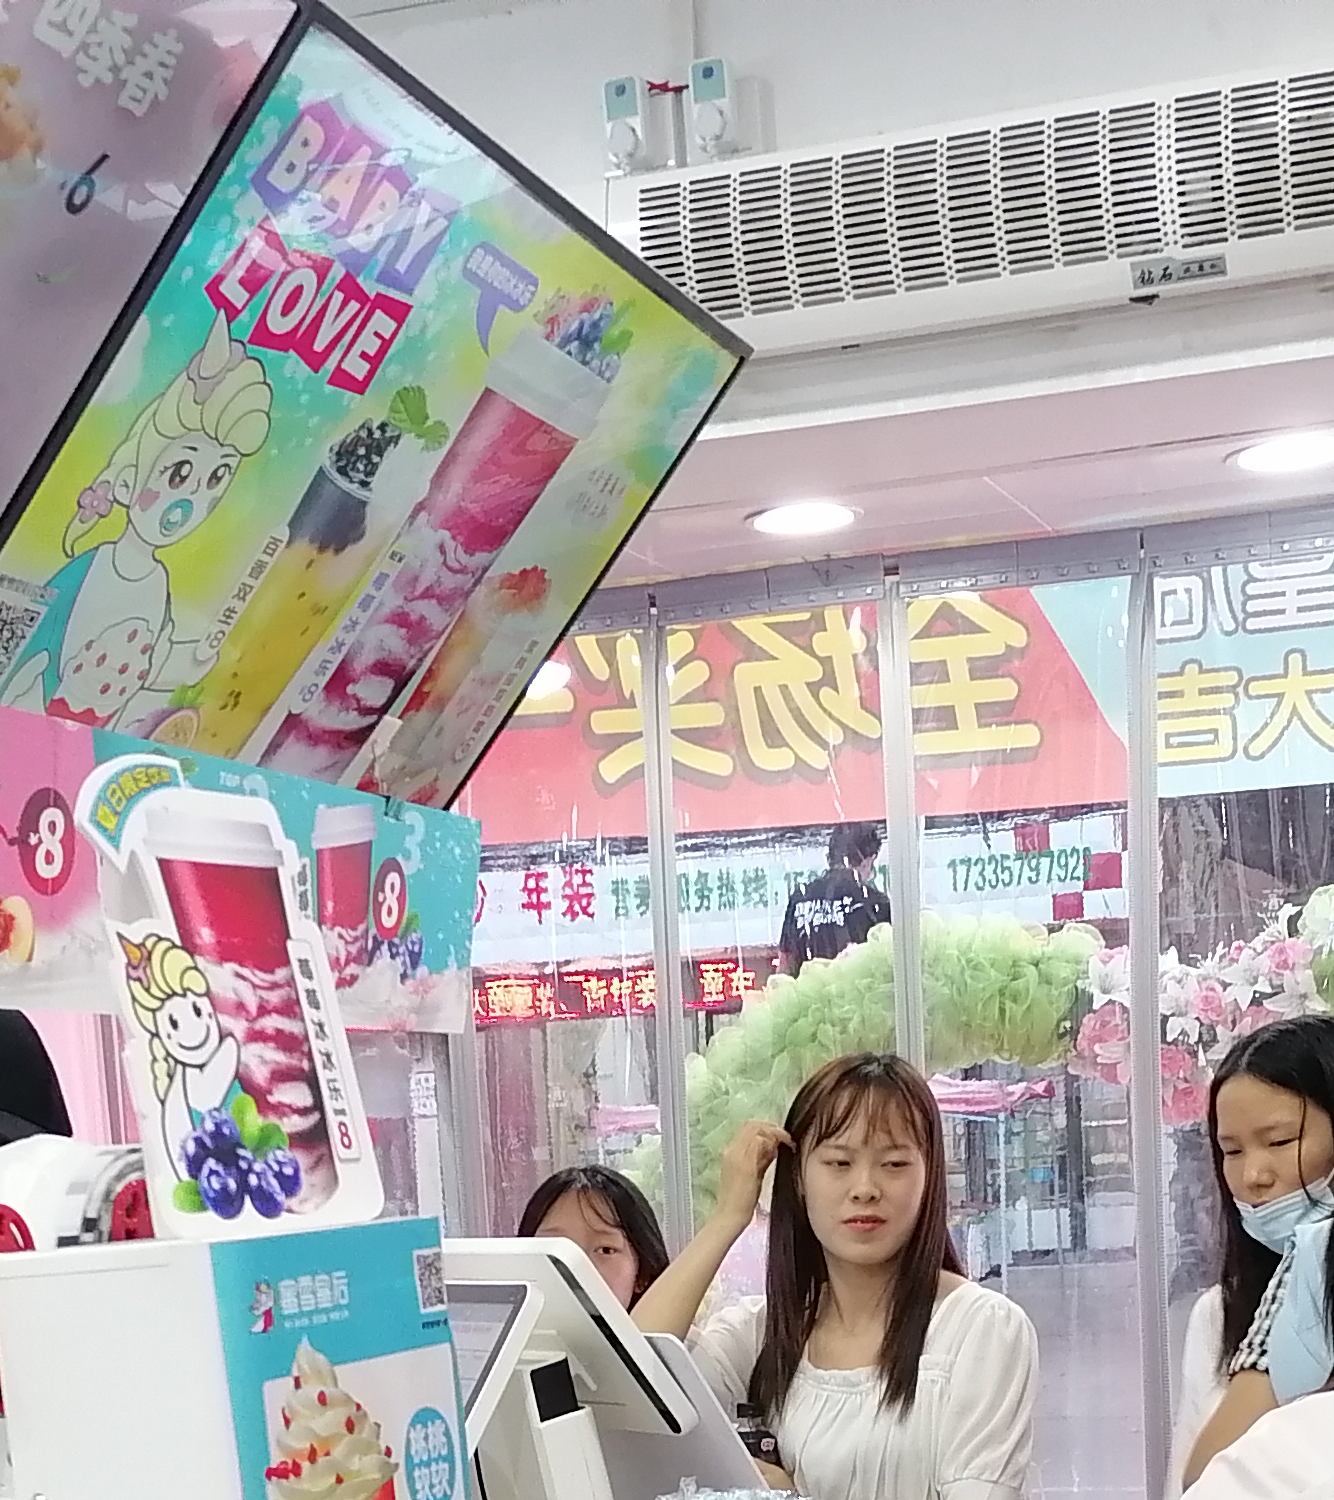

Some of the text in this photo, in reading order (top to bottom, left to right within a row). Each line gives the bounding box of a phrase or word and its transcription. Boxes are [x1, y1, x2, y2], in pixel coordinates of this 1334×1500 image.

[267, 115, 449, 275] BABY
[219, 230, 399, 377] LOVE
[34, 807, 65, 879] 8
[380, 871, 401, 929] 8
[337, 1121, 353, 1150] 8
[278, 1270, 349, 1315] 蜜雪皇后
